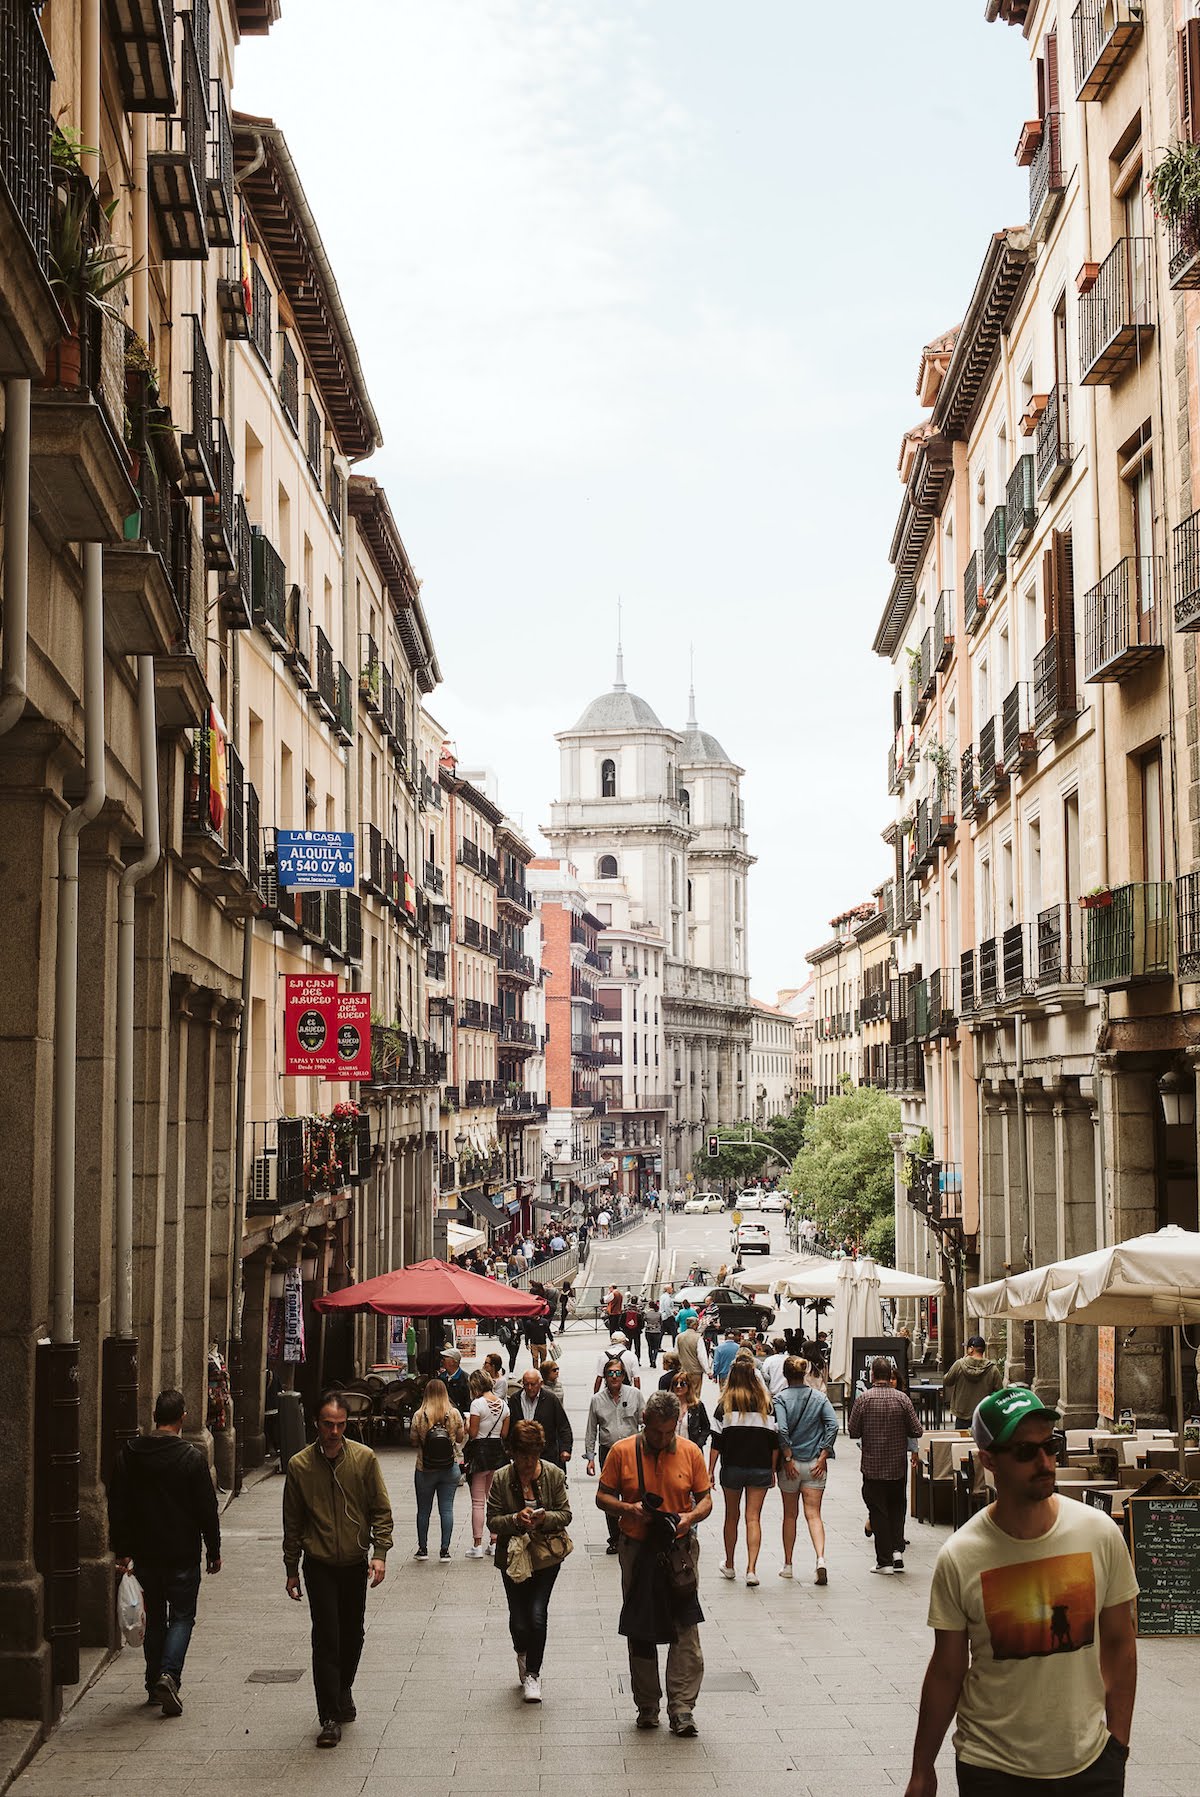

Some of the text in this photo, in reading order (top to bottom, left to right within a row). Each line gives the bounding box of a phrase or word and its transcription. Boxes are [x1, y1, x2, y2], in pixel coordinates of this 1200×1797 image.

[290, 832, 341, 842] LA CASA
[290, 847, 343, 860] ALQUILA
[280, 860, 352, 873] 91 540 07 80
[289, 979, 334, 988] LA CASA
[301, 988, 323, 996] DEL
[342, 997, 367, 1005] CASA
[288, 1293, 297, 1335] RONALDO
